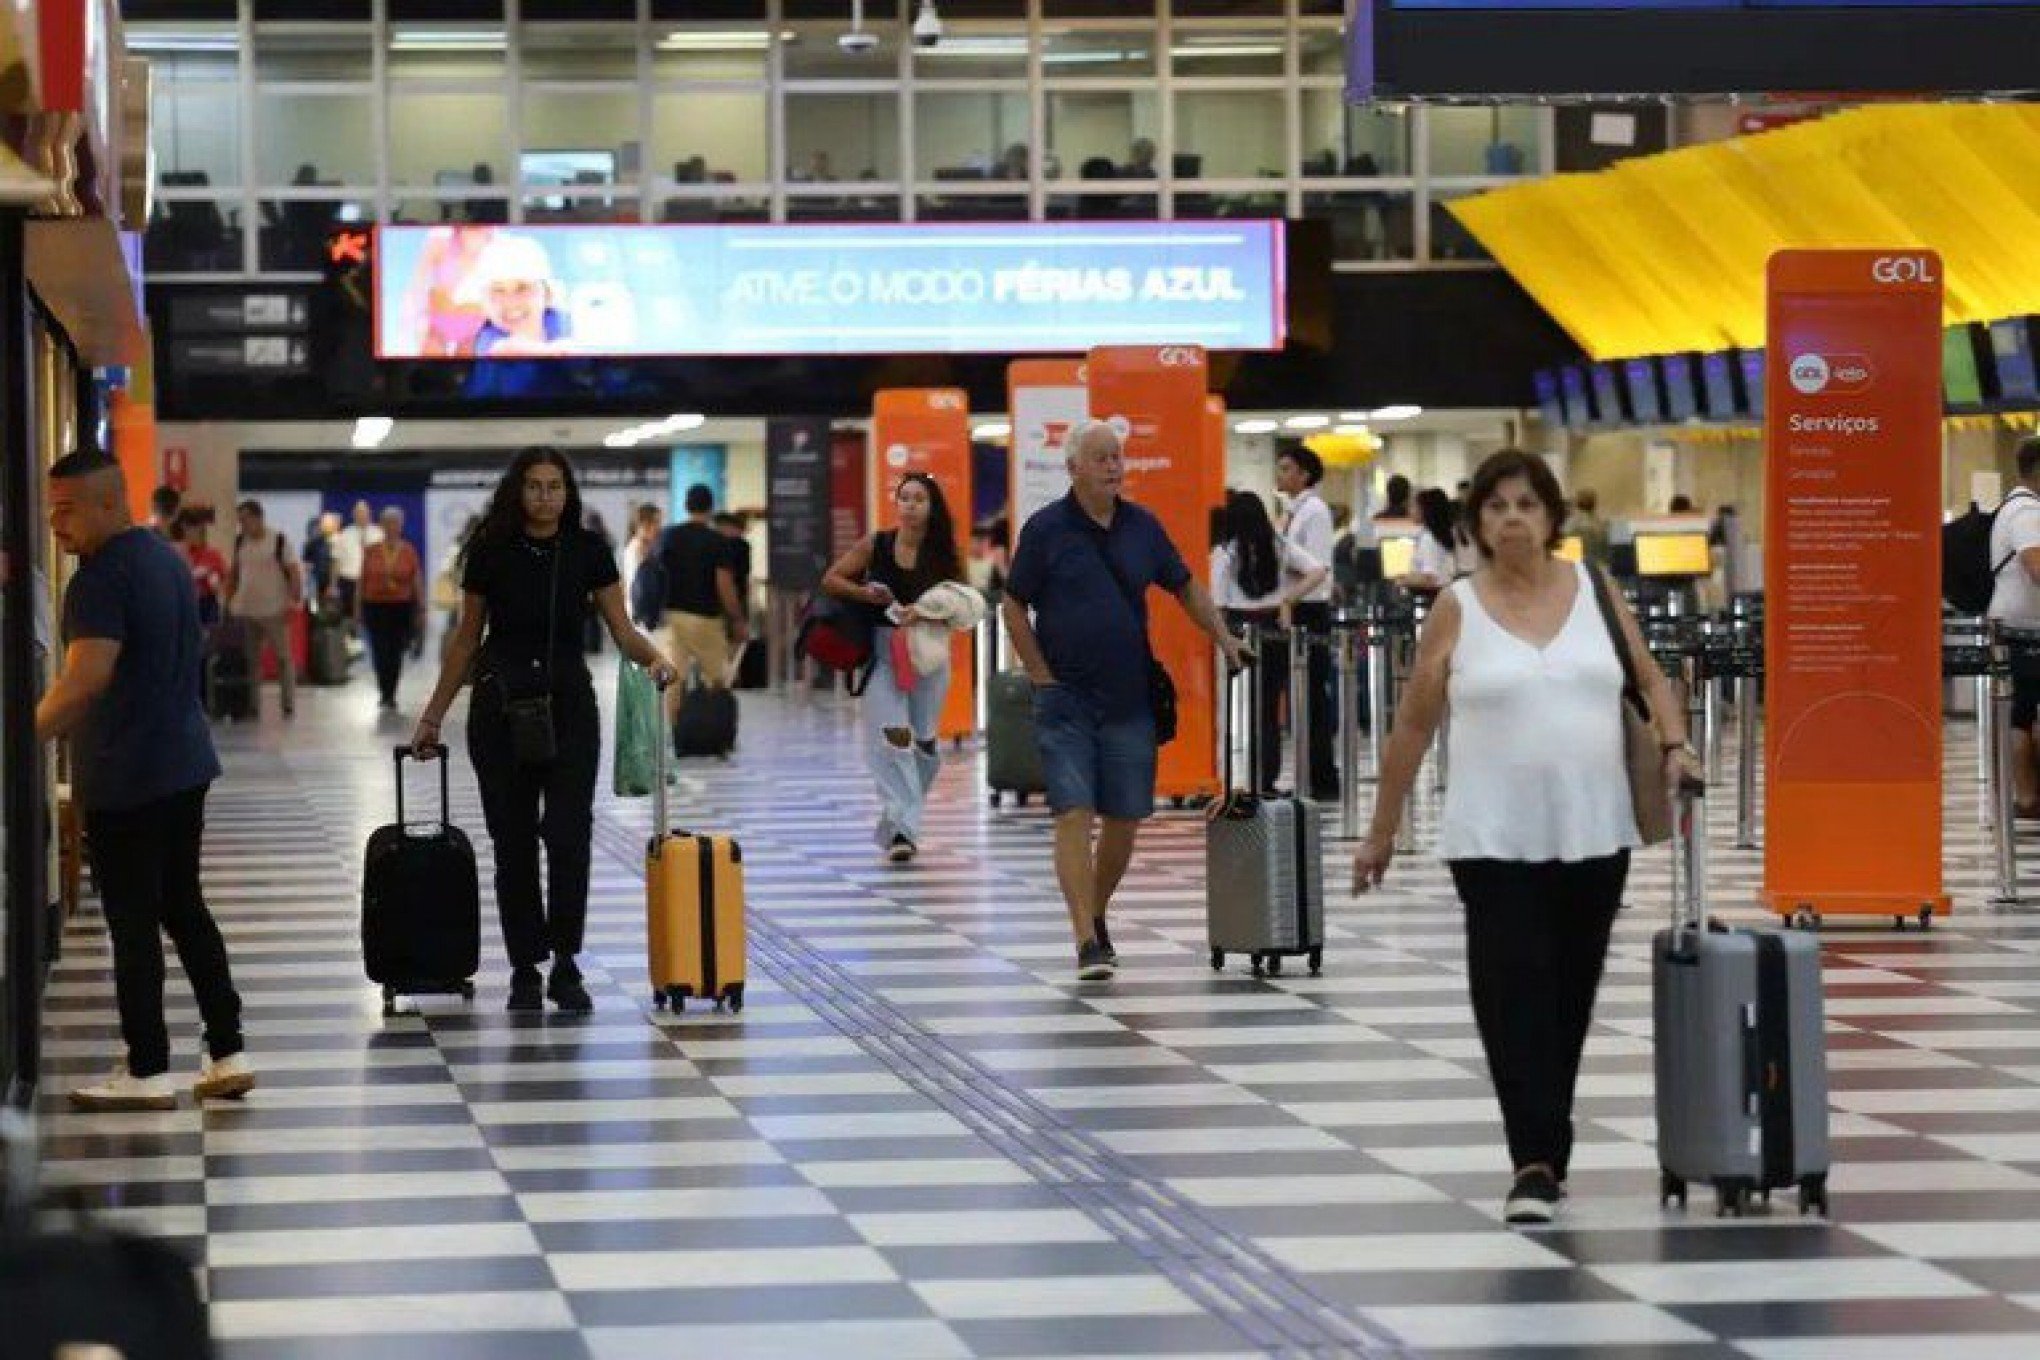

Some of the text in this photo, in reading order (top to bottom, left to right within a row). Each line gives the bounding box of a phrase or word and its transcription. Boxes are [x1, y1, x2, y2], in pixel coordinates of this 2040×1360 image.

[830, 268, 863, 304] O
[870, 268, 985, 304] MODO
[994, 259, 1132, 303] FÉRIAS
[1139, 266, 1246, 302] AZUL
[1872, 257, 1935, 283] GOL
[1790, 412, 1879, 436] Serviços
